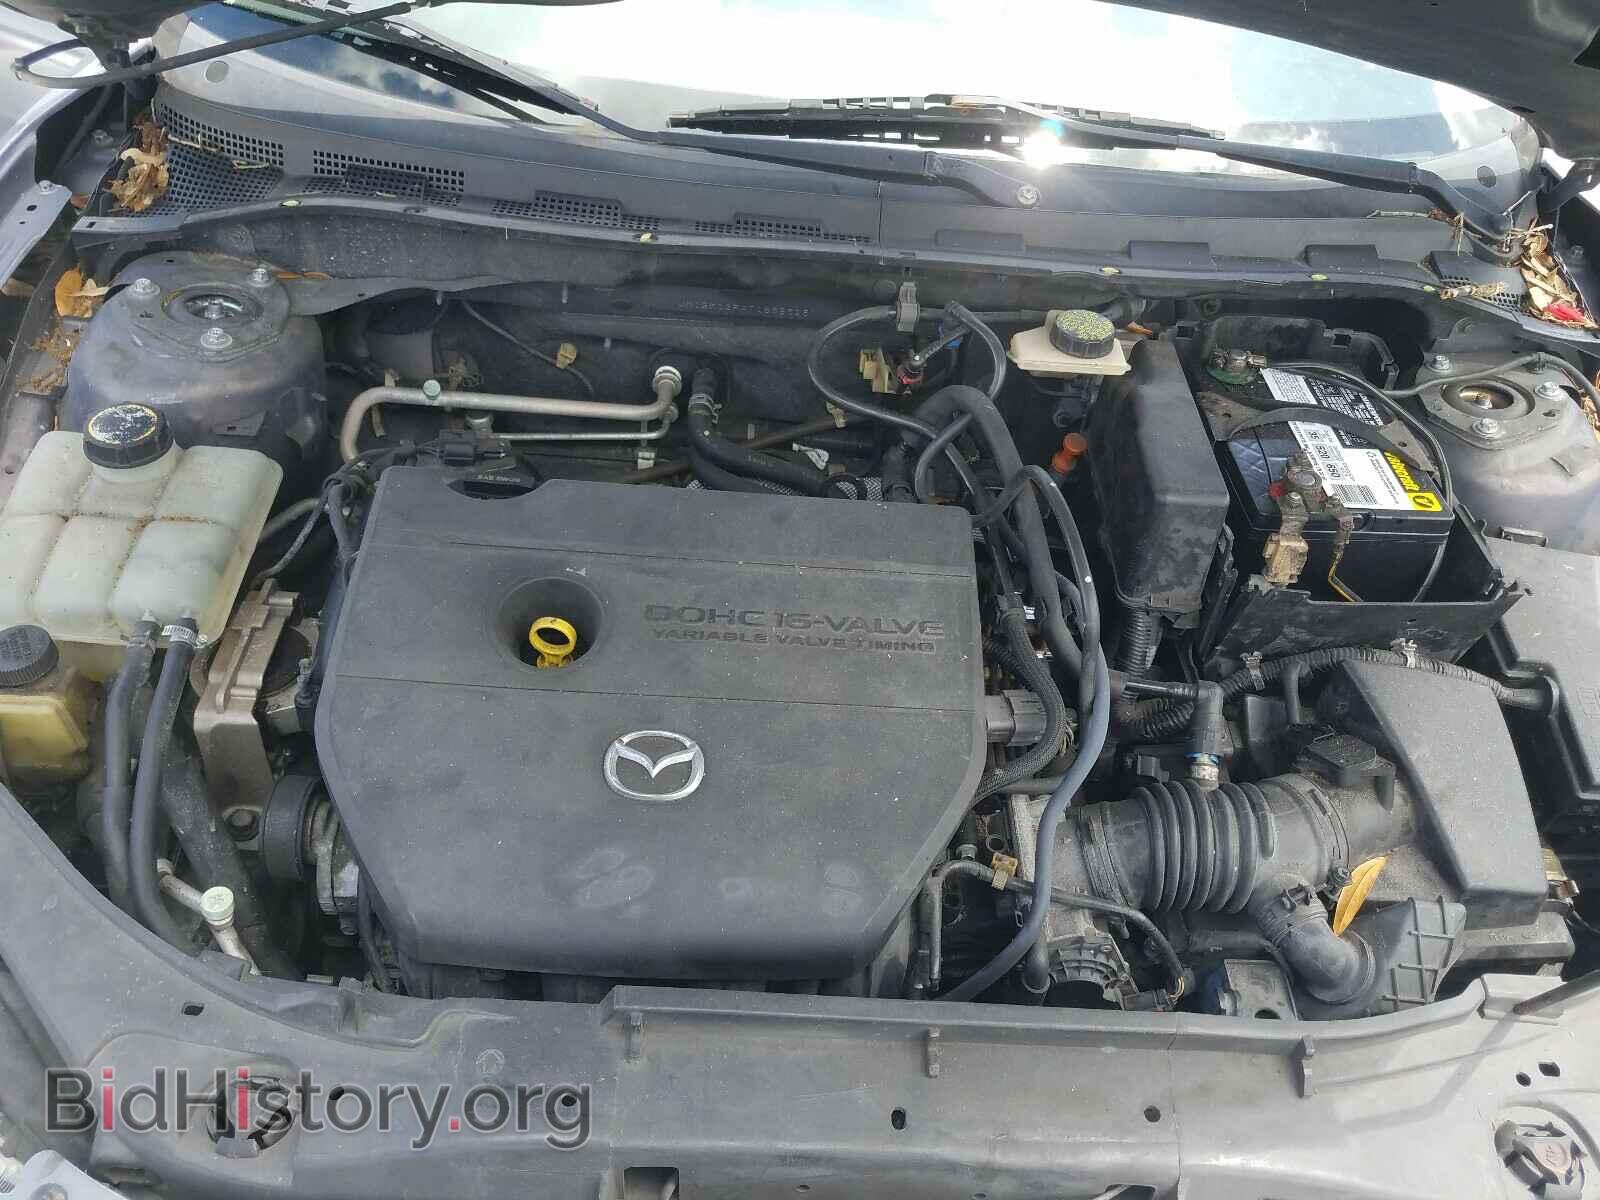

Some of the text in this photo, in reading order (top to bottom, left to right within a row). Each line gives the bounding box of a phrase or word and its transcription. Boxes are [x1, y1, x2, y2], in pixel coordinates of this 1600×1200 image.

[644, 604, 946, 638] DOHC 16-VALVE
[650, 628, 937, 654] VARIABLE VALVE TIMING
